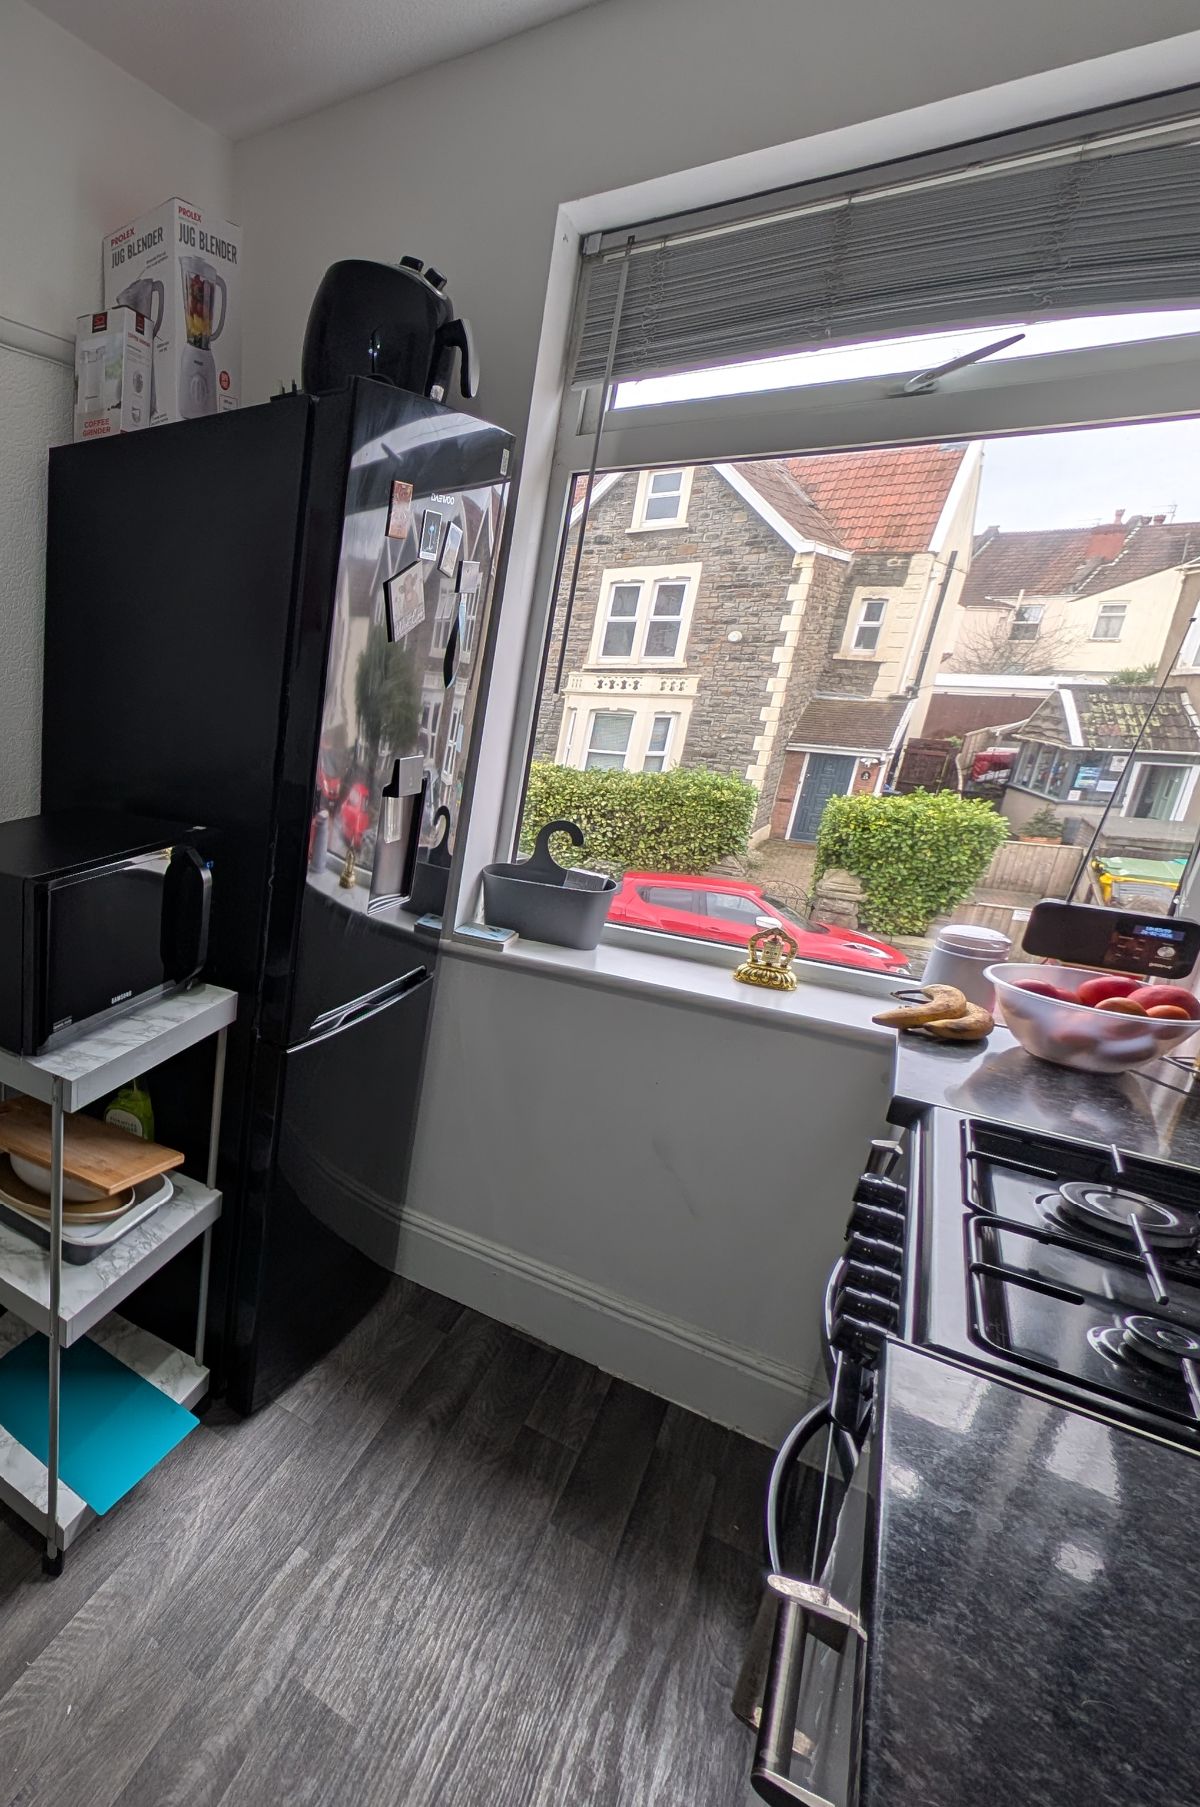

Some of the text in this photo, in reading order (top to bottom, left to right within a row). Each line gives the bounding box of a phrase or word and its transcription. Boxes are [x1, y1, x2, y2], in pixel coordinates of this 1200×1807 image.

[179, 206, 202, 223] PROLEX
[111, 227, 135, 247] PROLEX
[179, 223, 196, 248] JUG
[199, 230, 238, 265] BLENDER
[111, 247, 126, 269] JUG
[127, 227, 164, 260] BLENDER
[82, 426, 111, 437] GRINDER
[84, 418, 110, 428] COFFEE
[430, 493, 455, 505] DAEWOO
